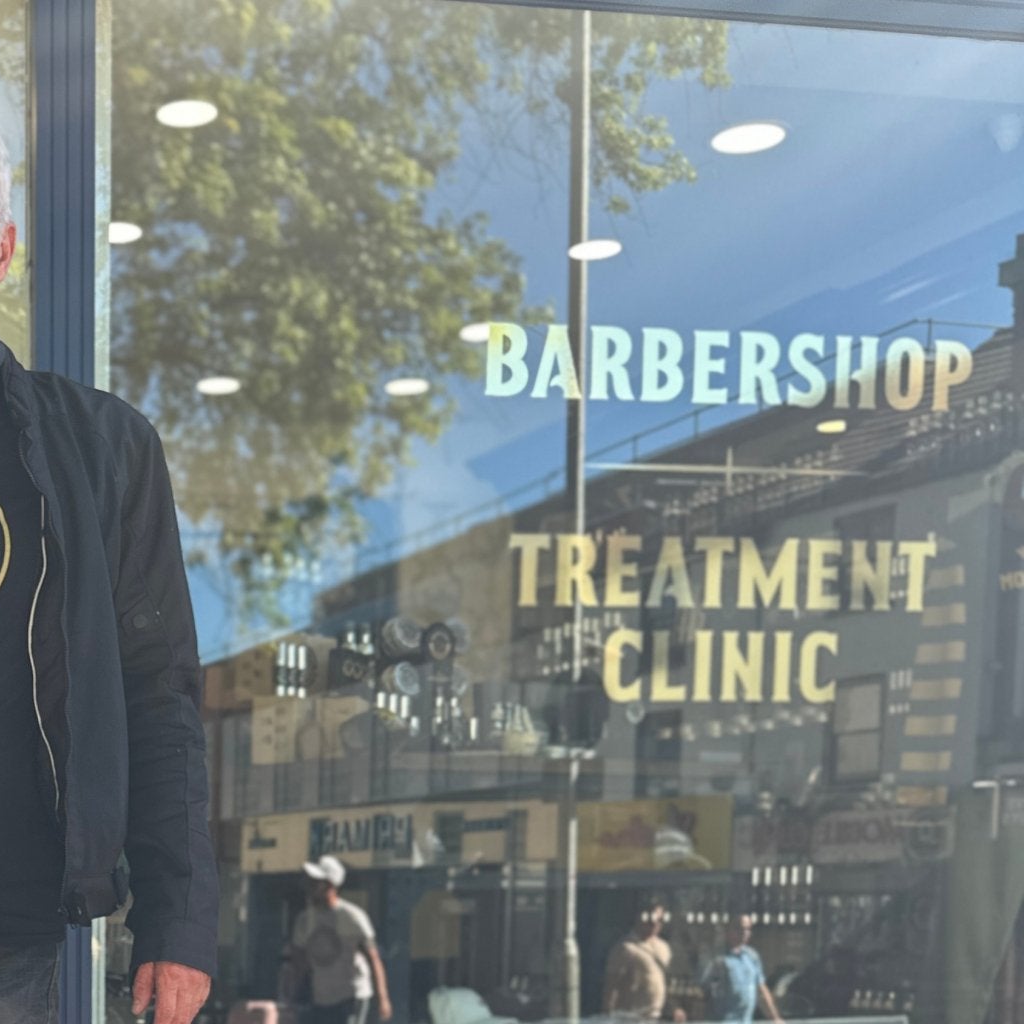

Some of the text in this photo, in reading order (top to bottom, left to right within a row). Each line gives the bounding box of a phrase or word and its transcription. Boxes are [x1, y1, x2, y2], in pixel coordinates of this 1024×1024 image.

[484, 321, 974, 412] BARBERSHOP
[507, 532, 938, 613] TREATMENT
[601, 628, 840, 704] CLINIC
